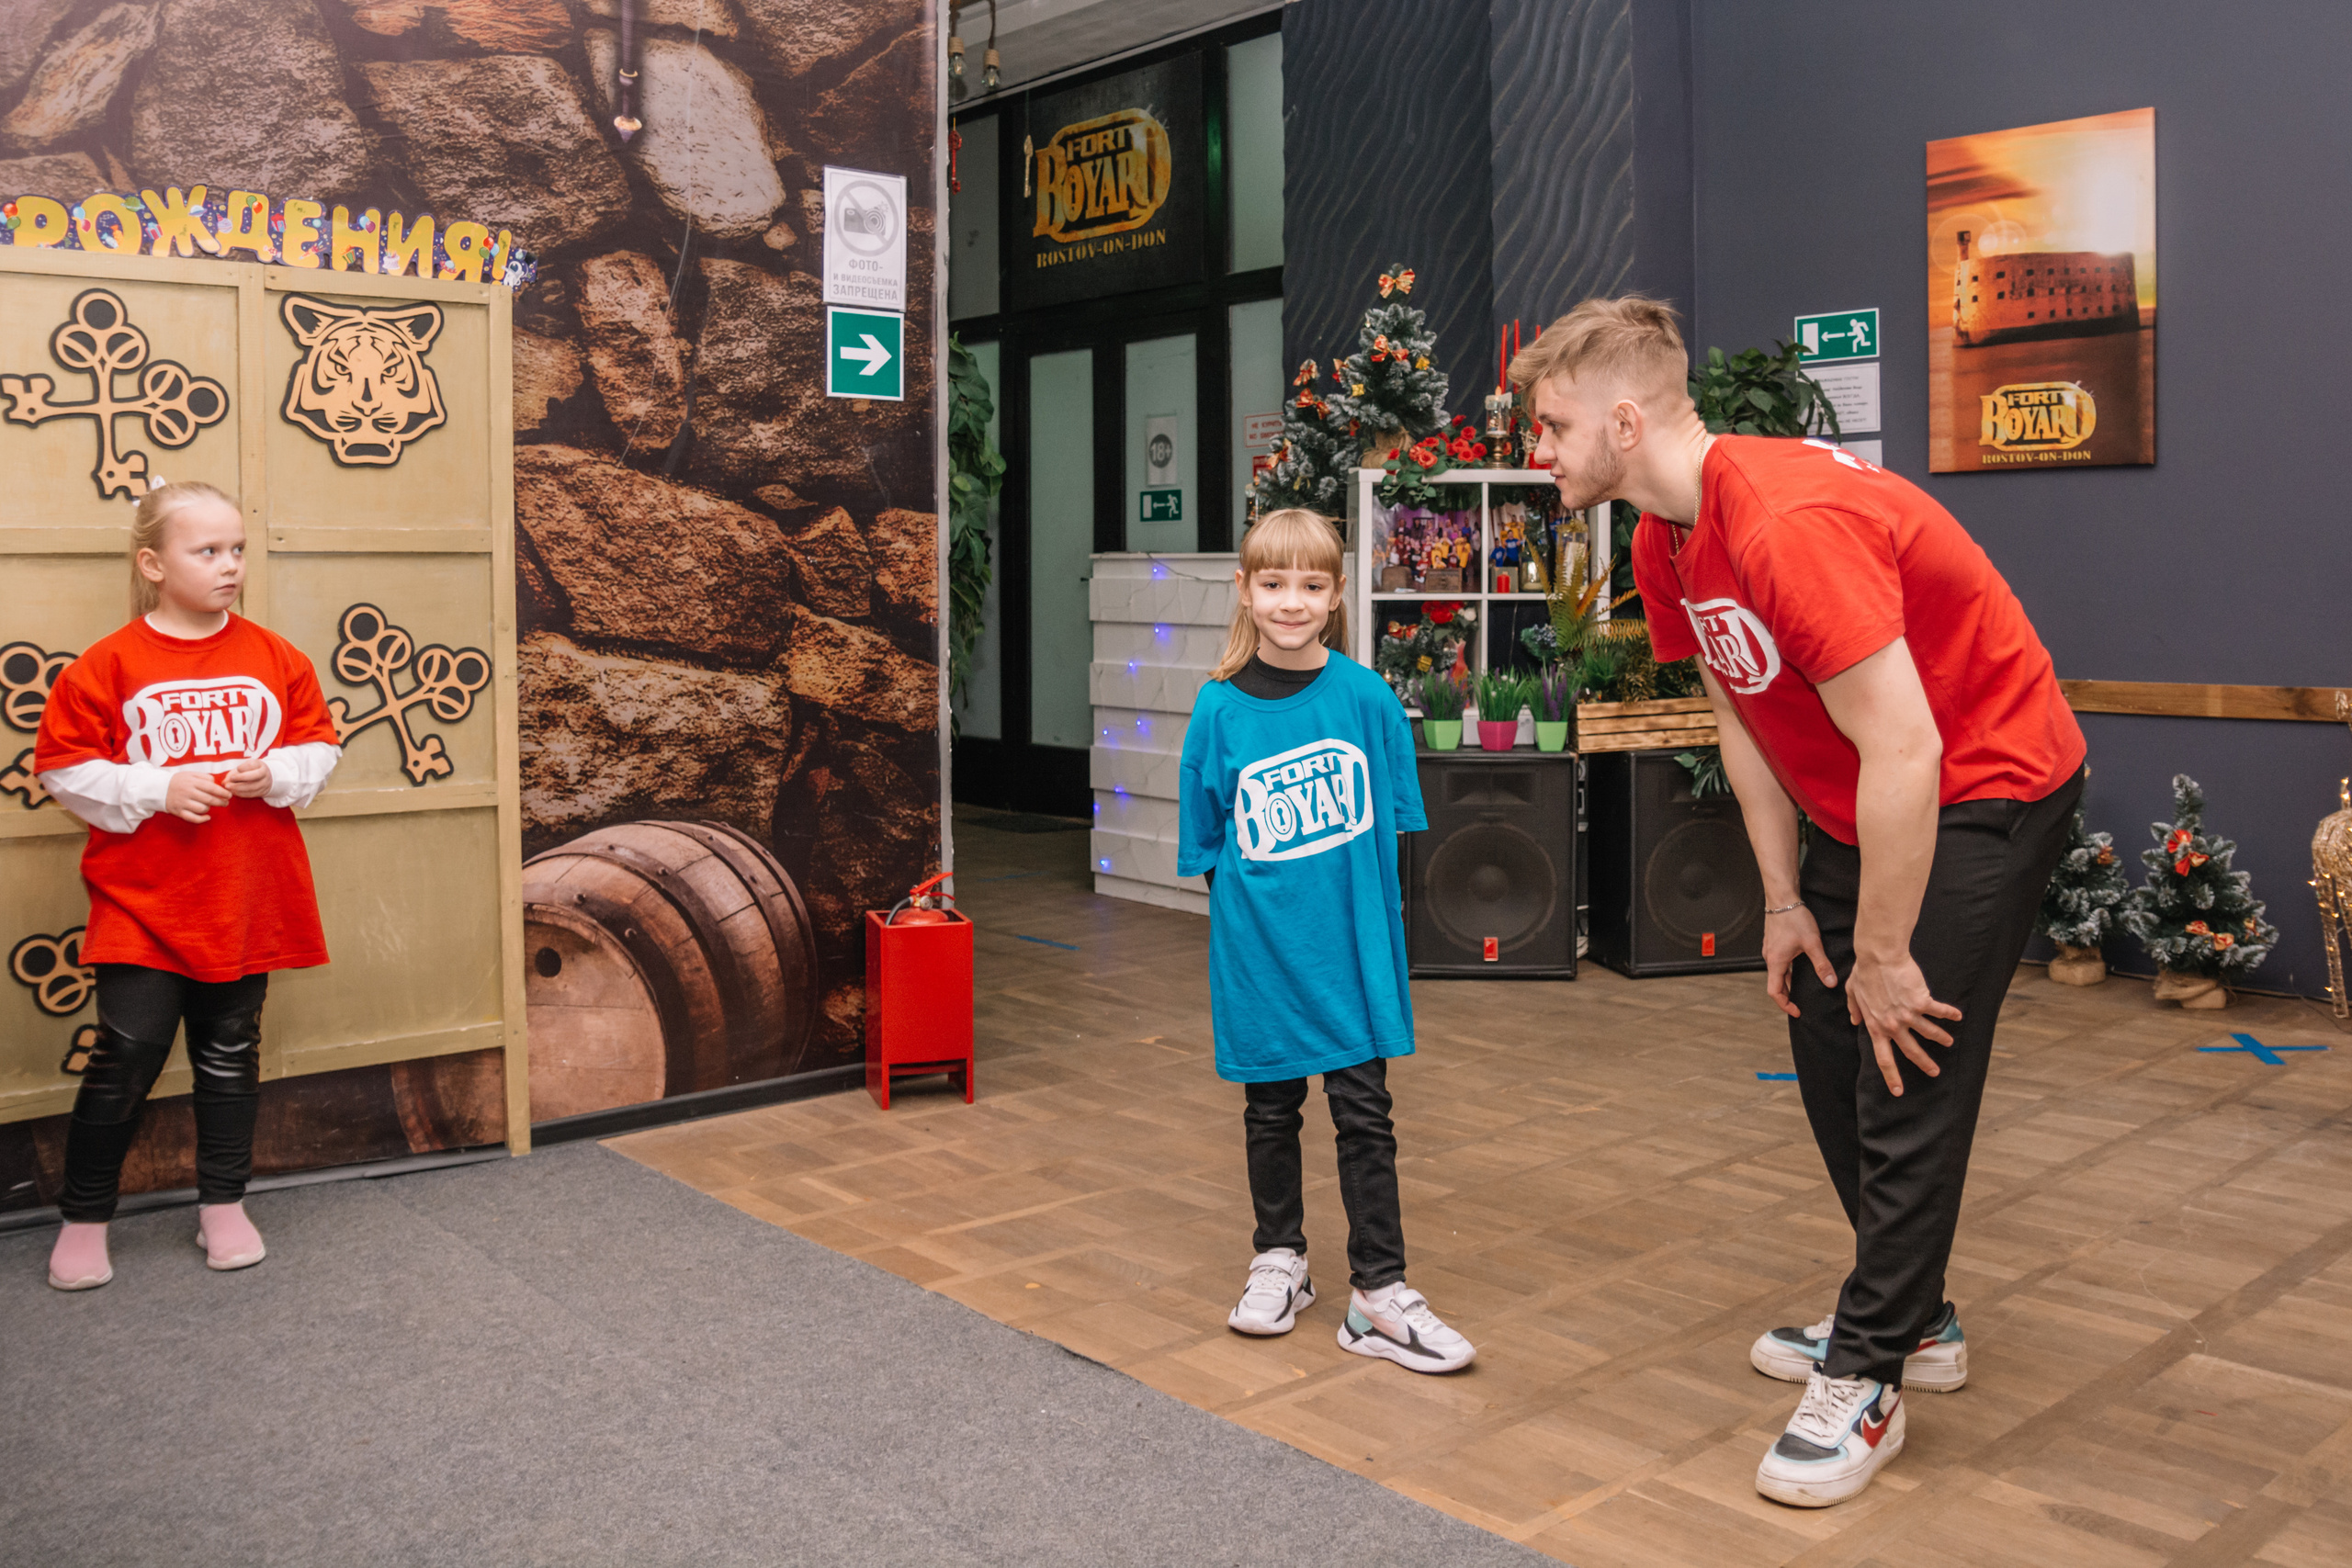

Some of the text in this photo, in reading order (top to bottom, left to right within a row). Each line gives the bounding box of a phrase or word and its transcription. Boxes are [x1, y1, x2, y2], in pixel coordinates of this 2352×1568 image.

[1066, 127, 1129, 162] FORT
[1033, 114, 1171, 239] BOYARD
[12, 184, 512, 286] РОЖДЕНИЯ!
[1036, 229, 1167, 268] ROSTOV-ON-DON
[833, 273, 839, 281] И
[848, 258, 884, 272] ФОТО-
[833, 284, 898, 300] ЗАПРЕЩЕНА
[2007, 390, 2062, 407] FORT
[1979, 386, 2097, 448] BOYARD
[1151, 442, 1171, 462] 18+
[1982, 450, 2092, 464] ROSTOV-ON-DON
[161, 687, 243, 712] FORT
[122, 682, 282, 768] BOYARD
[1261, 751, 1338, 793] FORT
[1234, 747, 1374, 861] BOYARD
